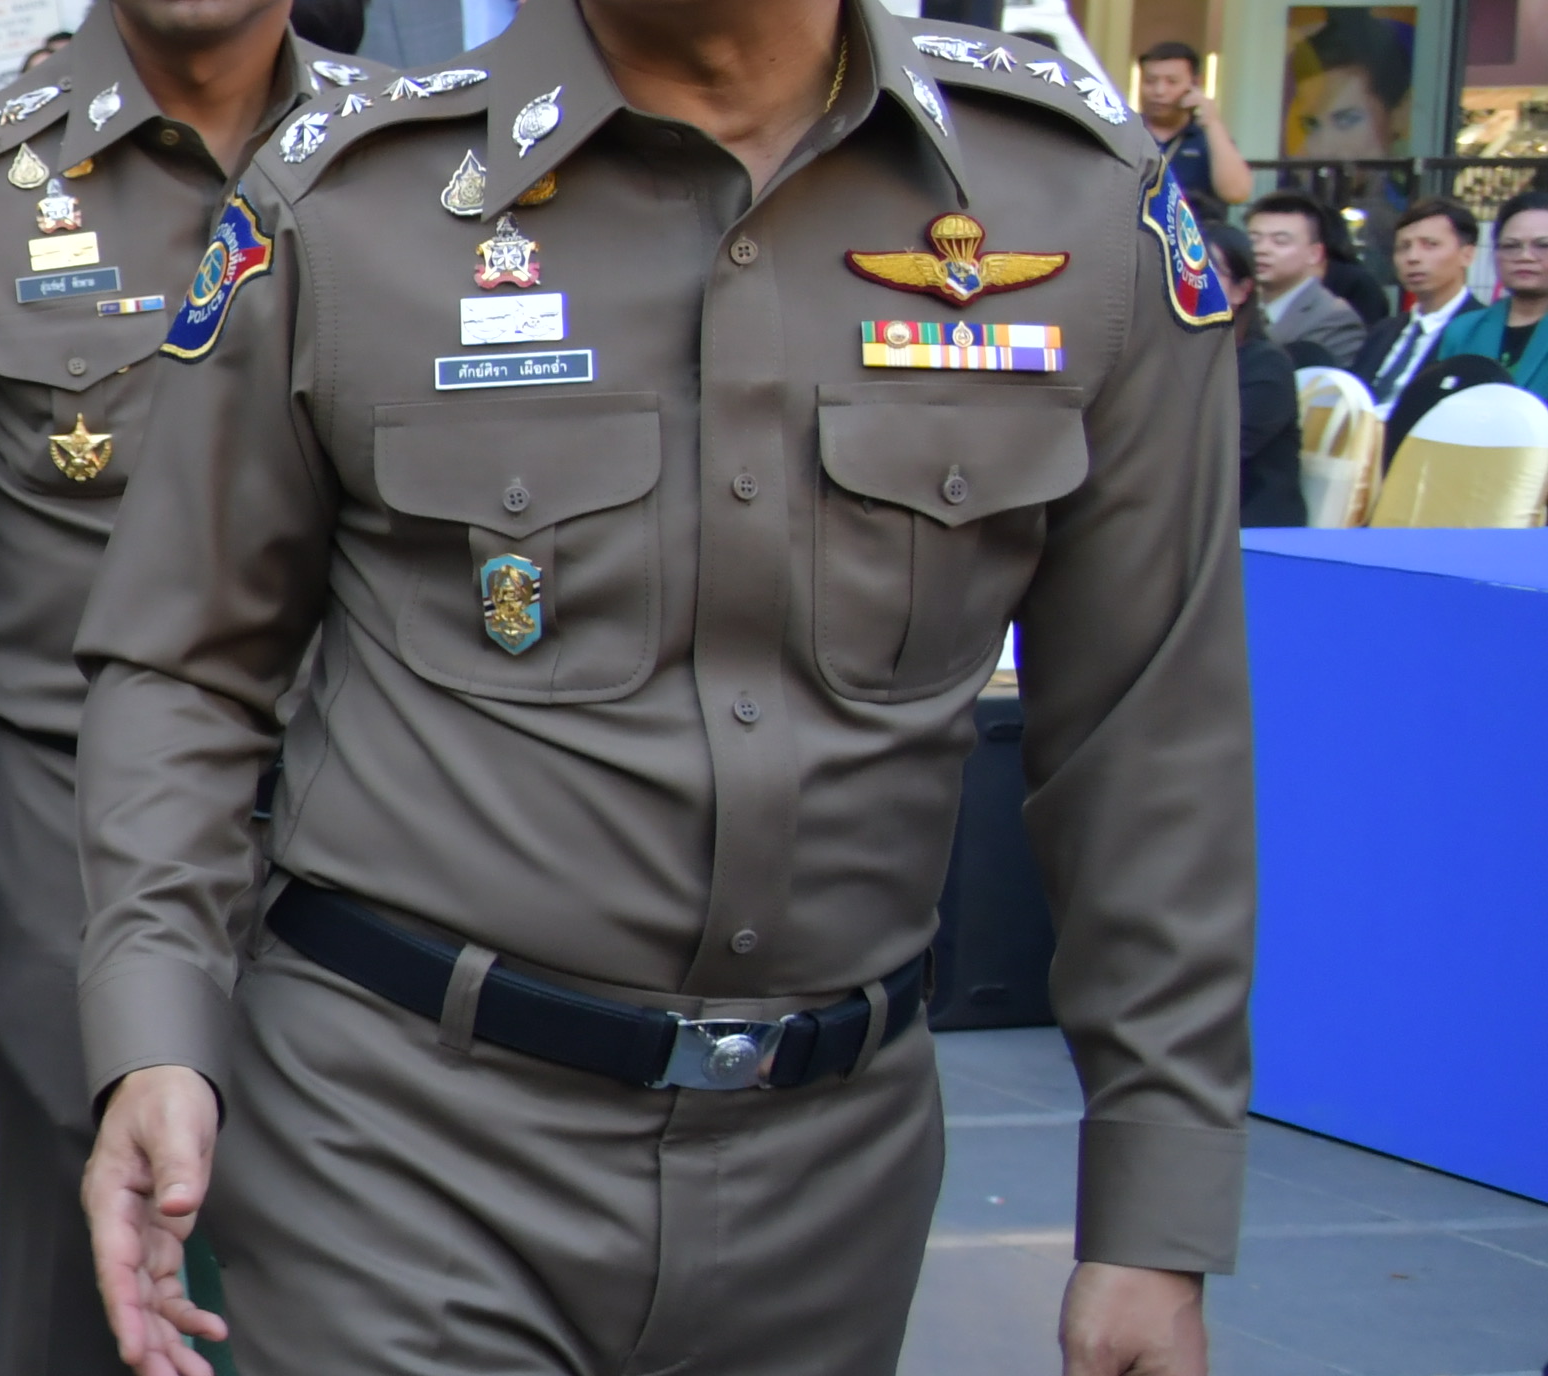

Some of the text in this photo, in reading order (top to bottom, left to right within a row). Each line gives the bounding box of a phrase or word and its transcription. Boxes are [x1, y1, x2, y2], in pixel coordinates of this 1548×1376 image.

[1171, 248, 1209, 290] TOURIST
[187, 290, 226, 325] POLICE
[458, 354, 568, 380] ศักย์ศิรา เผือกอ่ำ
